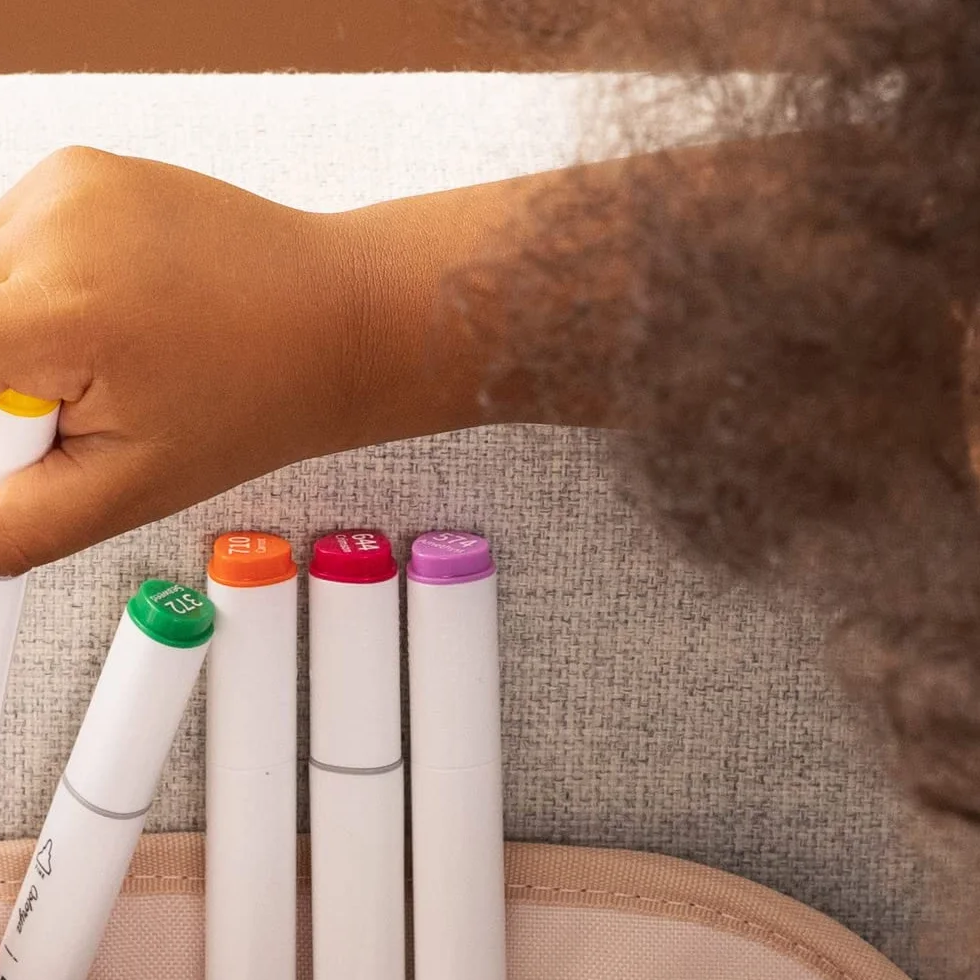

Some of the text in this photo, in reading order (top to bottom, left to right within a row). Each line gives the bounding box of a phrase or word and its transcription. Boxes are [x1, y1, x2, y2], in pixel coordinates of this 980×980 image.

[227, 536, 251, 555] 710
[351, 533, 380, 552] 644
[432, 532, 478, 548] 574
[164, 593, 204, 615] 372
